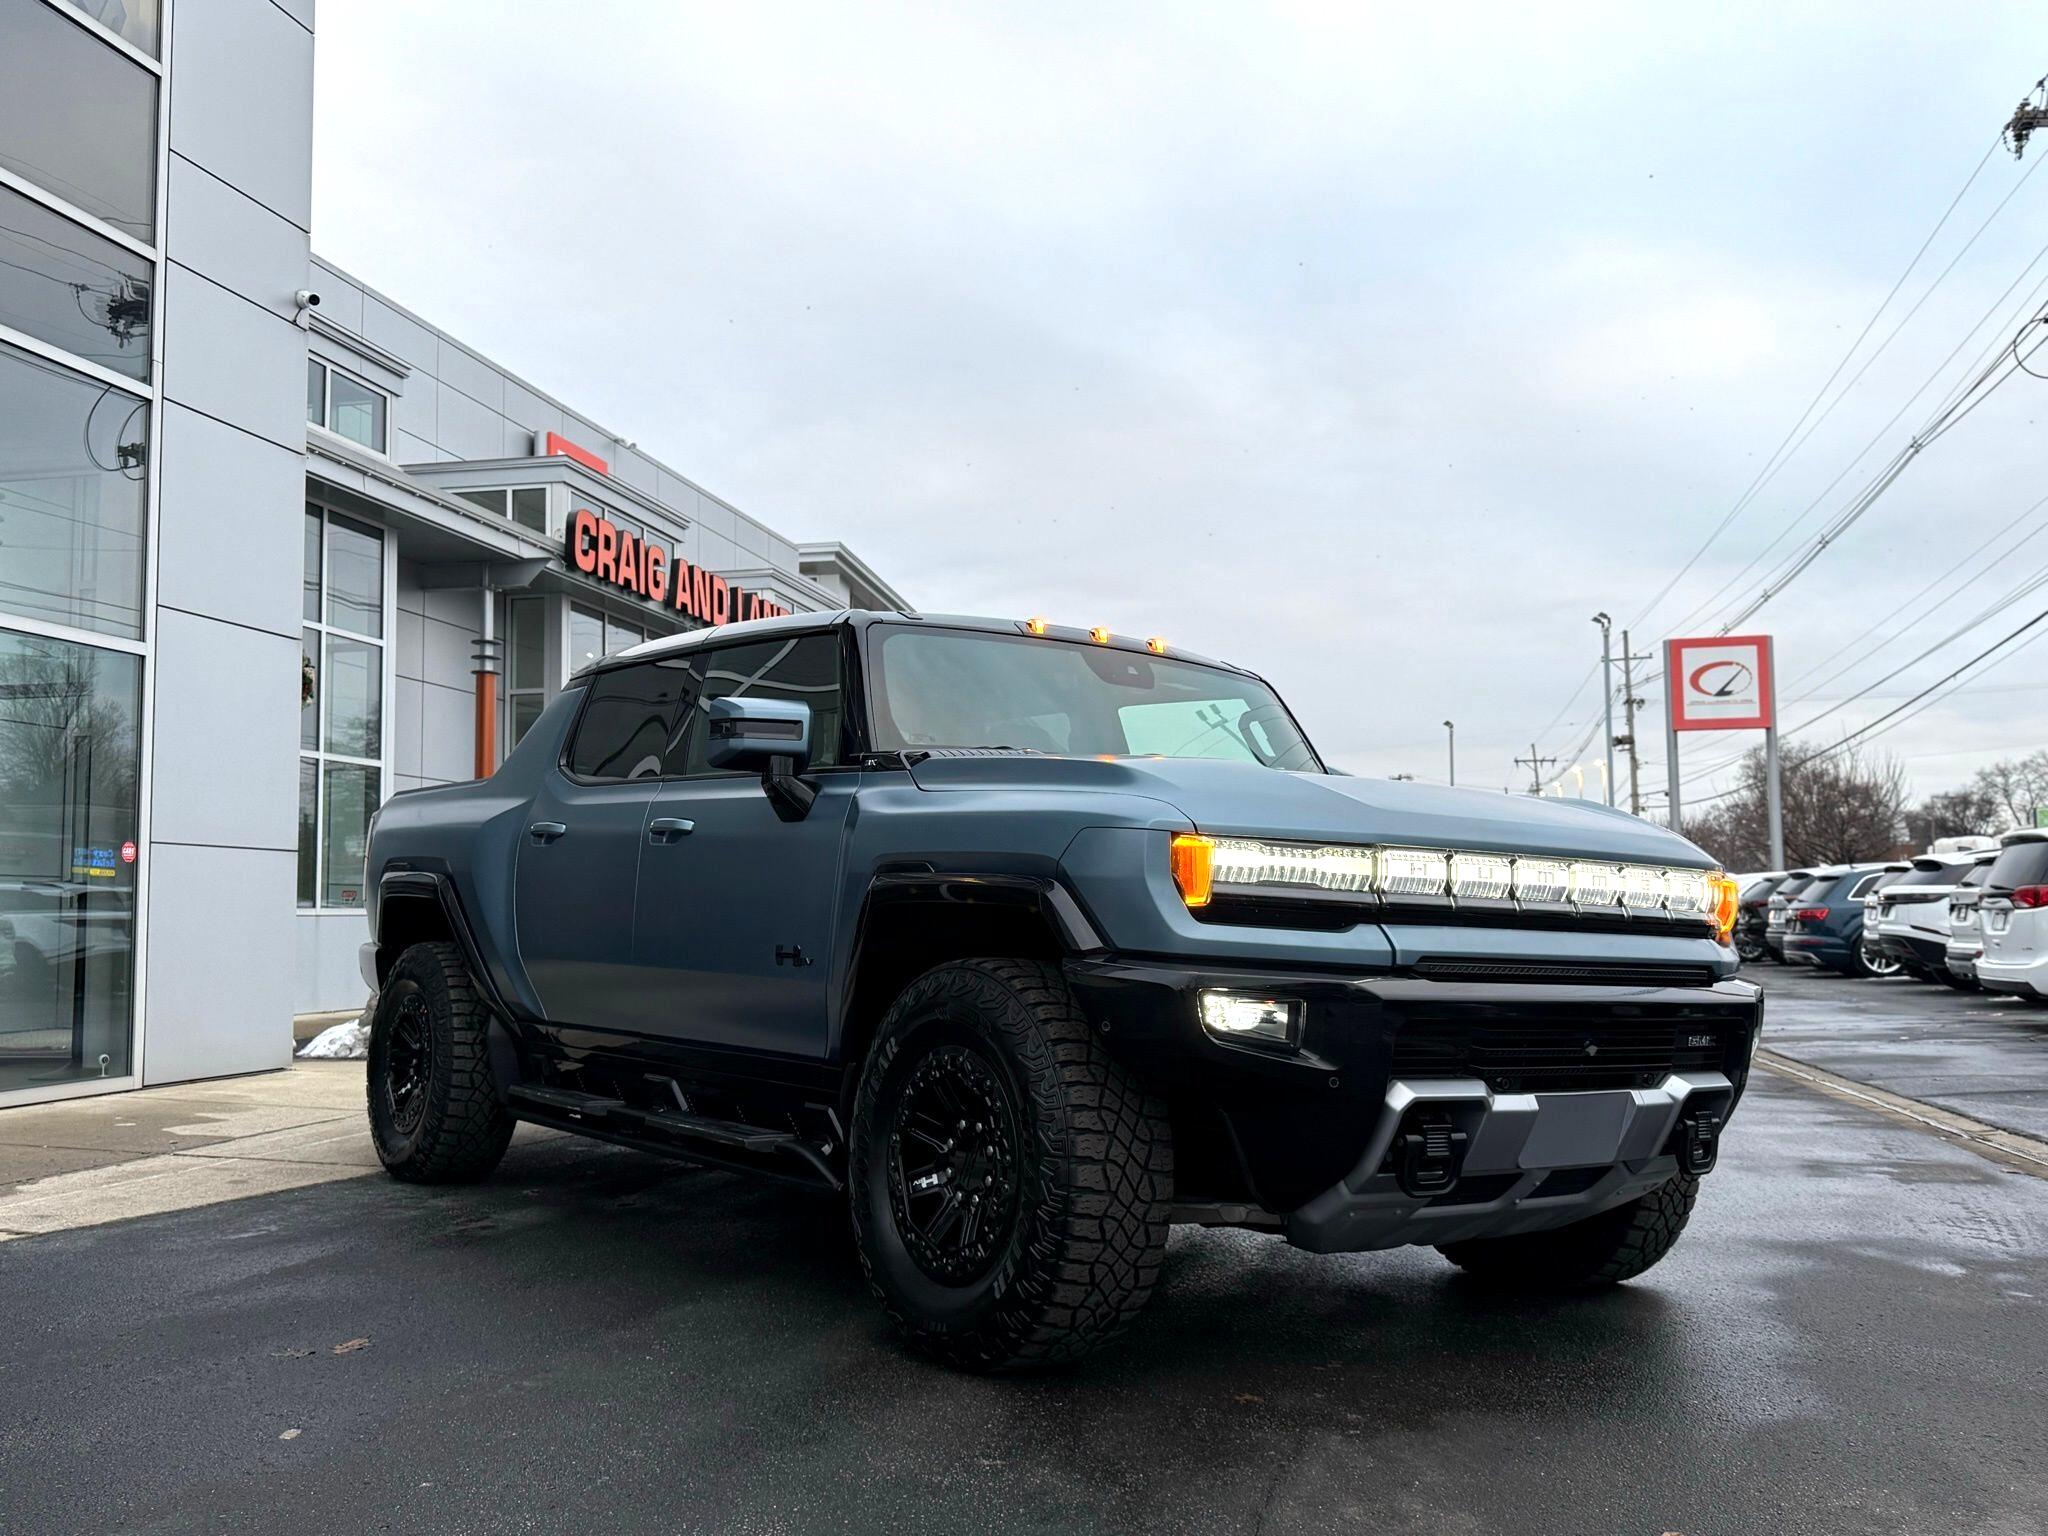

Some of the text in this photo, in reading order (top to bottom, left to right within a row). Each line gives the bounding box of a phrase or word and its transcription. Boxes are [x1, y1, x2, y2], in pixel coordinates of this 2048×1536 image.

[572, 508, 792, 627] CRAIG AND LA
